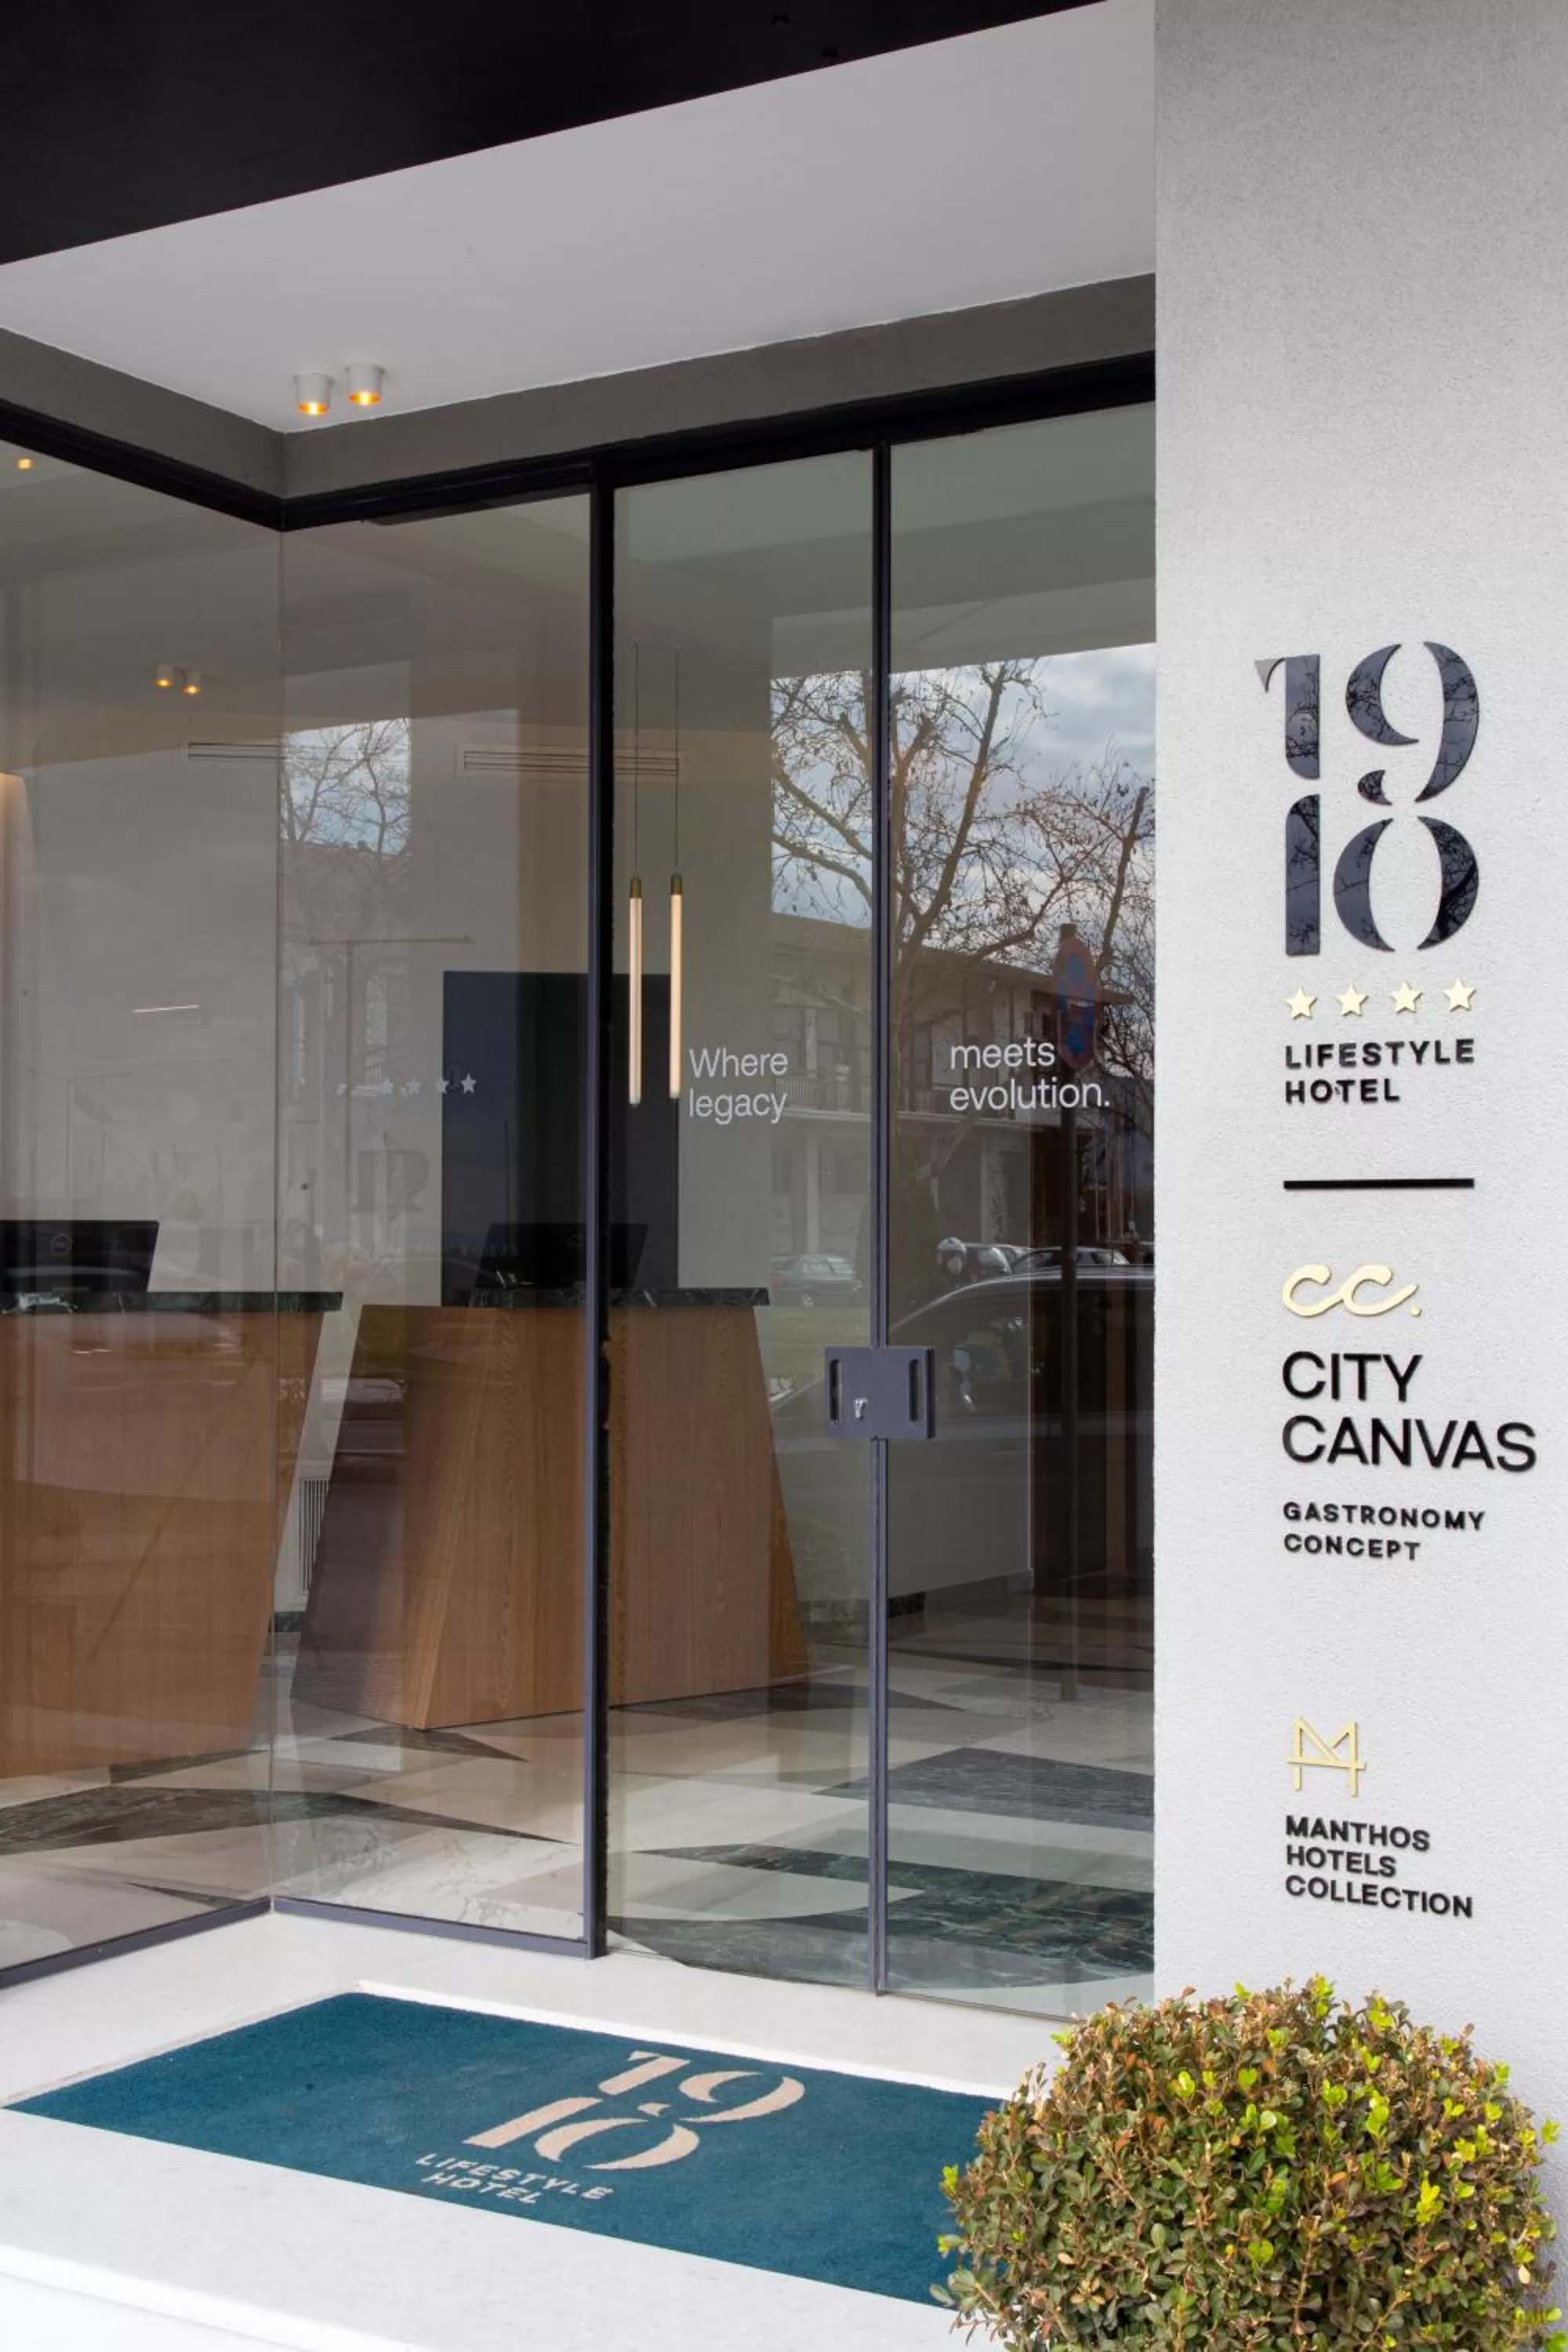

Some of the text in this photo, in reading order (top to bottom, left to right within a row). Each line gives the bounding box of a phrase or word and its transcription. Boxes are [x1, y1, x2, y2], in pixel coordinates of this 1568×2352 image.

[1254, 641, 1480, 804] 19
[689, 1047, 789, 1078] Where
[949, 1037, 1055, 1069] meets
[1285, 1038, 1475, 1069] LIFESTYLE
[689, 1087, 788, 1125] legacy
[949, 1077, 1110, 1112] evolution.
[1285, 1078, 1401, 1105] HOTEL
[1282, 1350, 1424, 1403] CITY
[1282, 1414, 1537, 1473] CANVAS
[1283, 1501, 1486, 1531] GASTRONOMY
[1283, 1533, 1421, 1561] CONCEPT
[1285, 1815, 1431, 1852] MANTHOS
[1286, 1844, 1397, 1878] HOTELS
[1285, 1875, 1473, 1918] COLLECTION
[414, 2153, 615, 2200] LIFESTYLE
[421, 2172, 543, 2205] HOTEL
